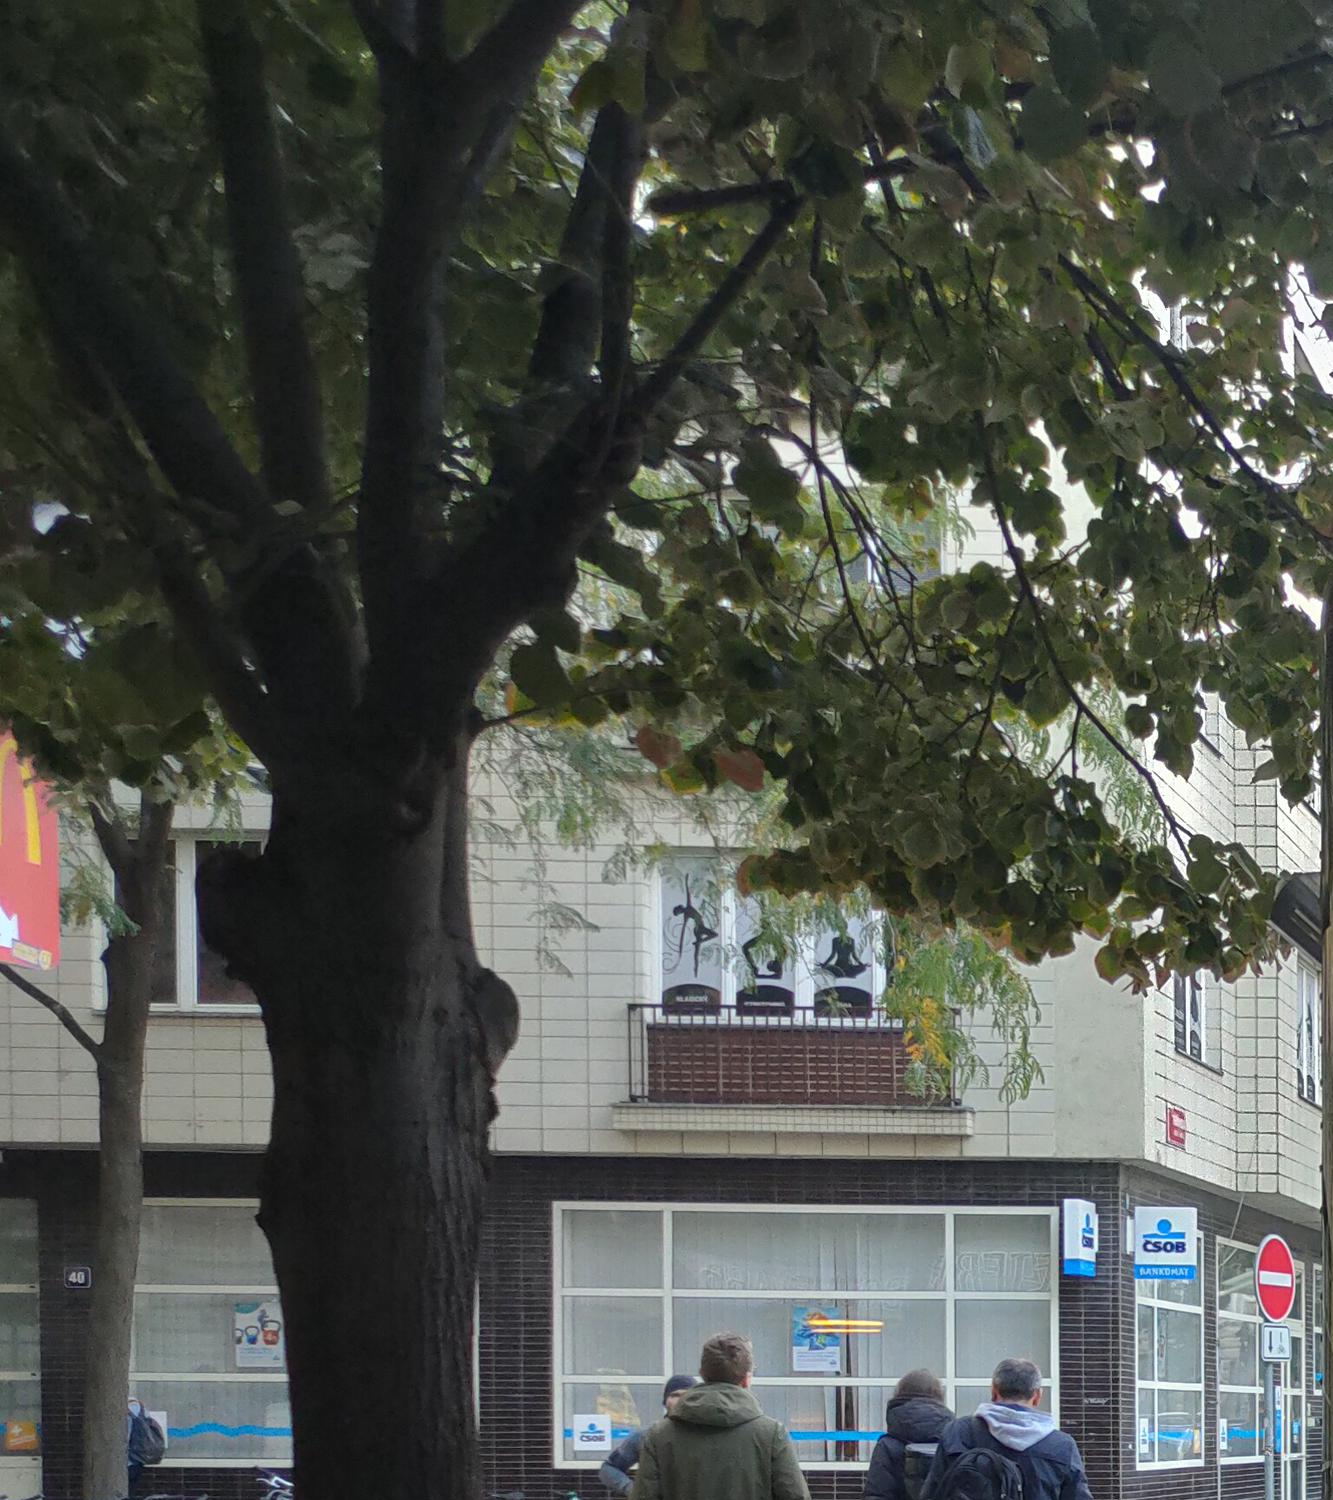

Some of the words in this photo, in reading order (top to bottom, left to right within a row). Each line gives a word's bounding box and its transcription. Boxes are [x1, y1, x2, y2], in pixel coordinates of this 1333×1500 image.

[1142, 1239, 1186, 1254] ČSOB
[68, 1271, 85, 1284] 40
[1139, 1267, 1189, 1277] BANKOMAT
